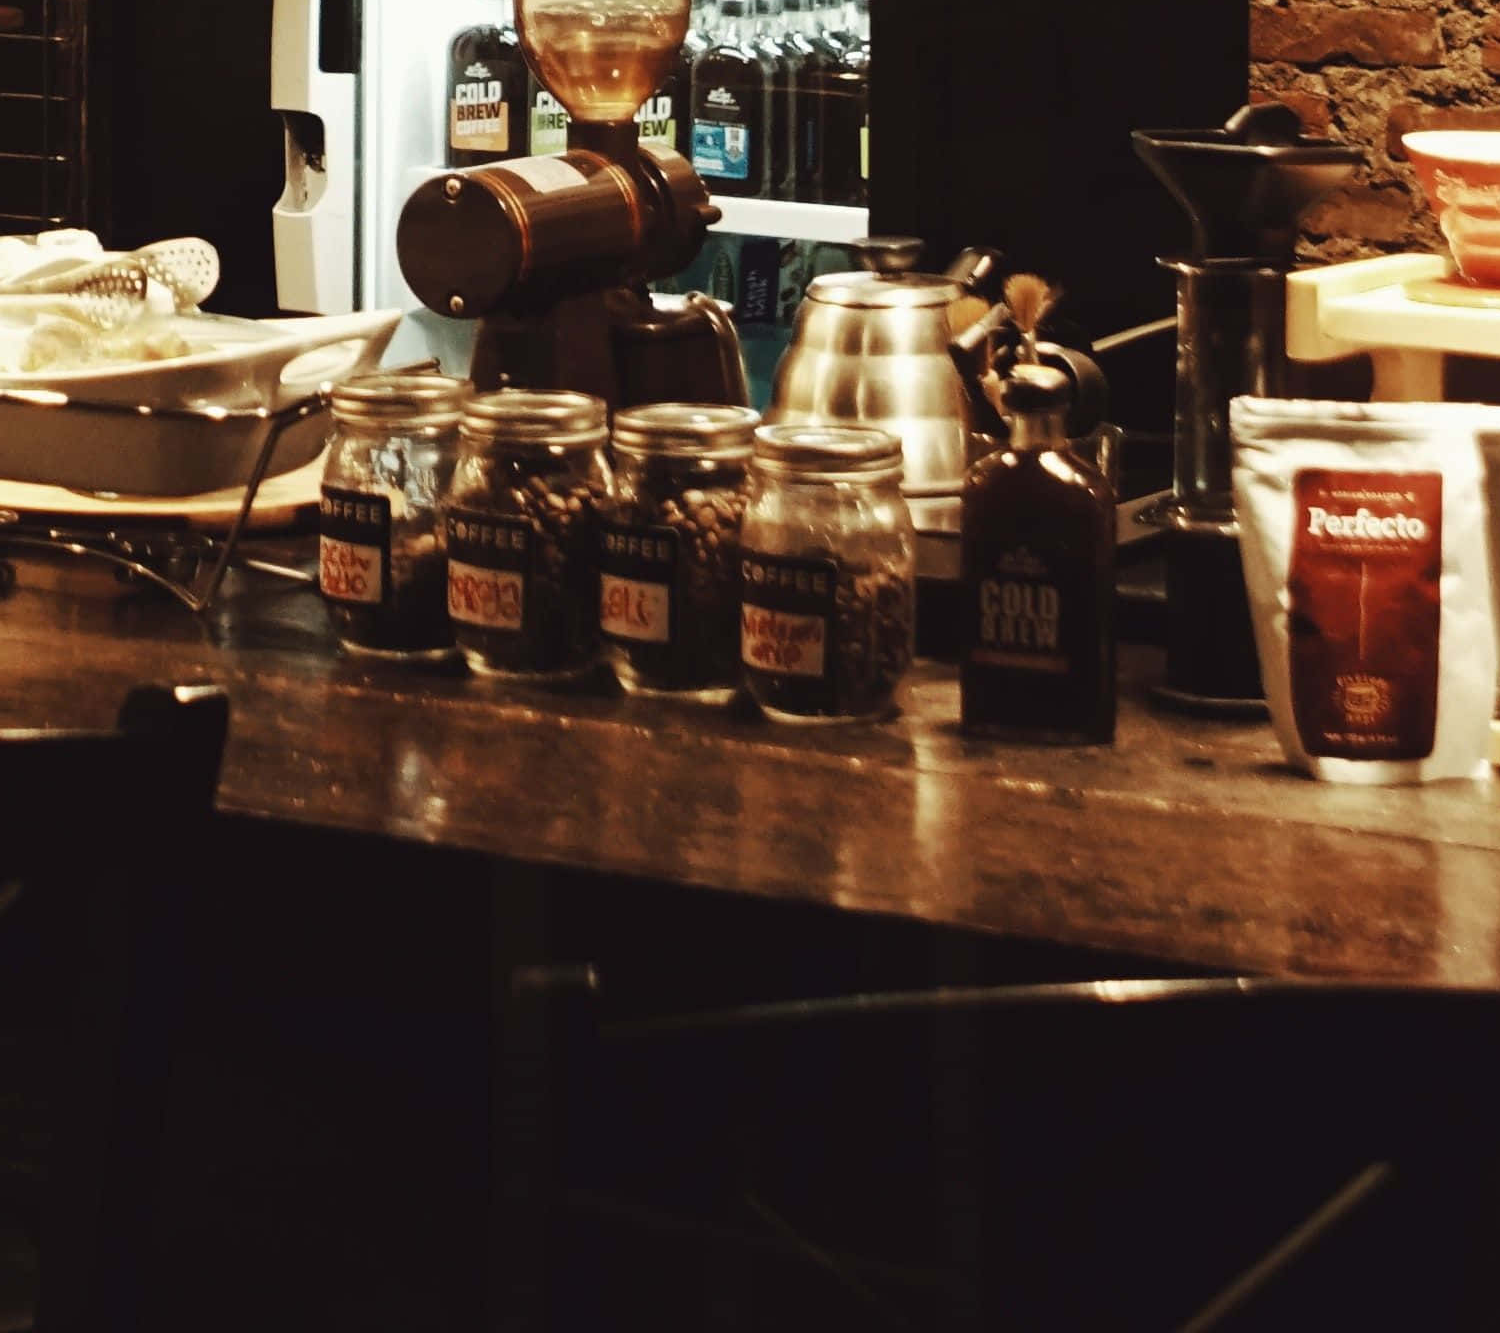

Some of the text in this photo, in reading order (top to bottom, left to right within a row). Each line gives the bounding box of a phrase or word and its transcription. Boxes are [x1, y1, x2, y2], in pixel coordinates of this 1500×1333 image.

[455, 80, 503, 105] COLD
[456, 102, 502, 122] BREW
[536, 111, 569, 131] BRE
[640, 96, 672, 121] LD
[641, 119, 669, 137] EW
[320, 497, 383, 526] OFFEE
[1307, 506, 1428, 541] Perfecto
[447, 516, 527, 550] COFFEE
[600, 532, 672, 560] OFFEE
[742, 558, 830, 595] COFFEE
[979, 580, 1063, 622] COLD
[980, 614, 1062, 651] BREW
